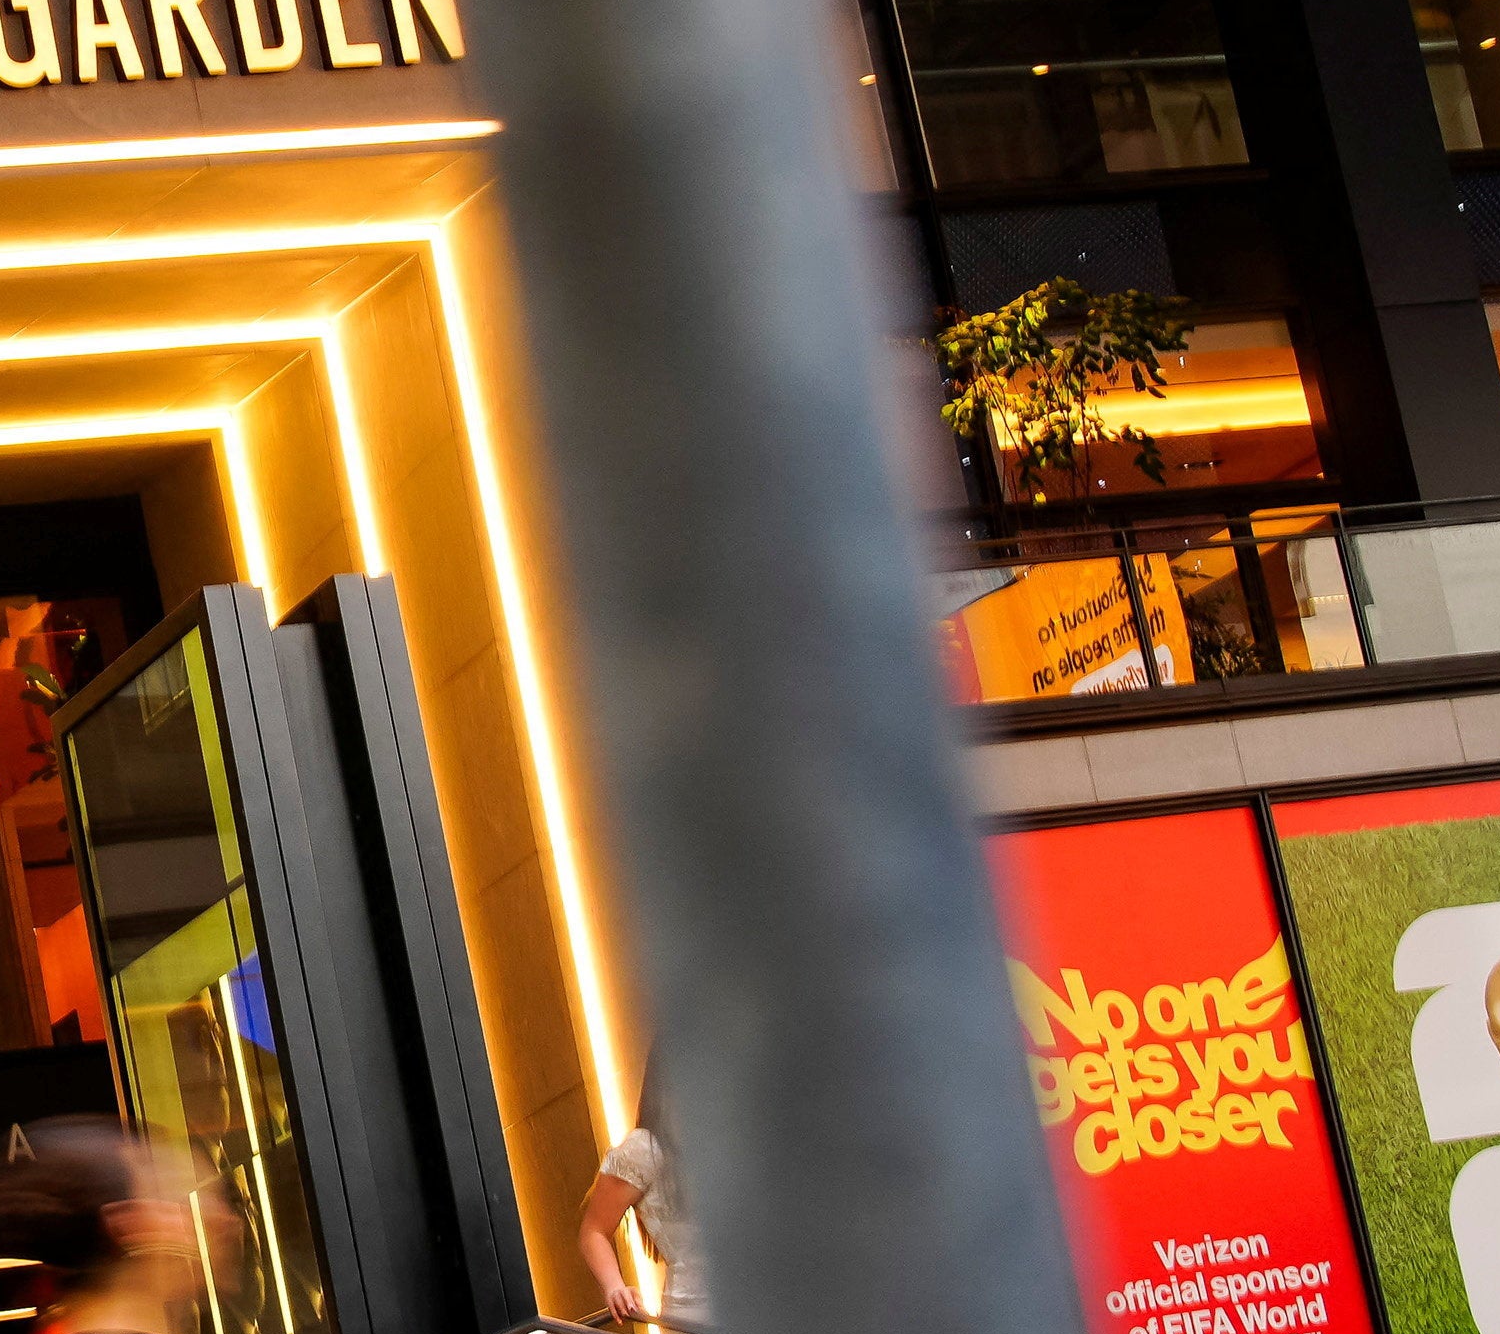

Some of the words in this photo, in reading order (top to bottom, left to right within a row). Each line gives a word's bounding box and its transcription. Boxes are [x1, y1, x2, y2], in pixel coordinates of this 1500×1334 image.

[1004, 956, 1139, 1047] No
[1143, 931, 1291, 1035] one
[1027, 1038, 1180, 1127] gets
[1175, 1018, 1315, 1103] you
[1074, 1089, 1299, 1176] closer
[1153, 1233, 1269, 1271] Verizon
[1106, 1272, 1208, 1316] official
[1211, 1261, 1331, 1304] sponsor
[1235, 1293, 1328, 1334] World
